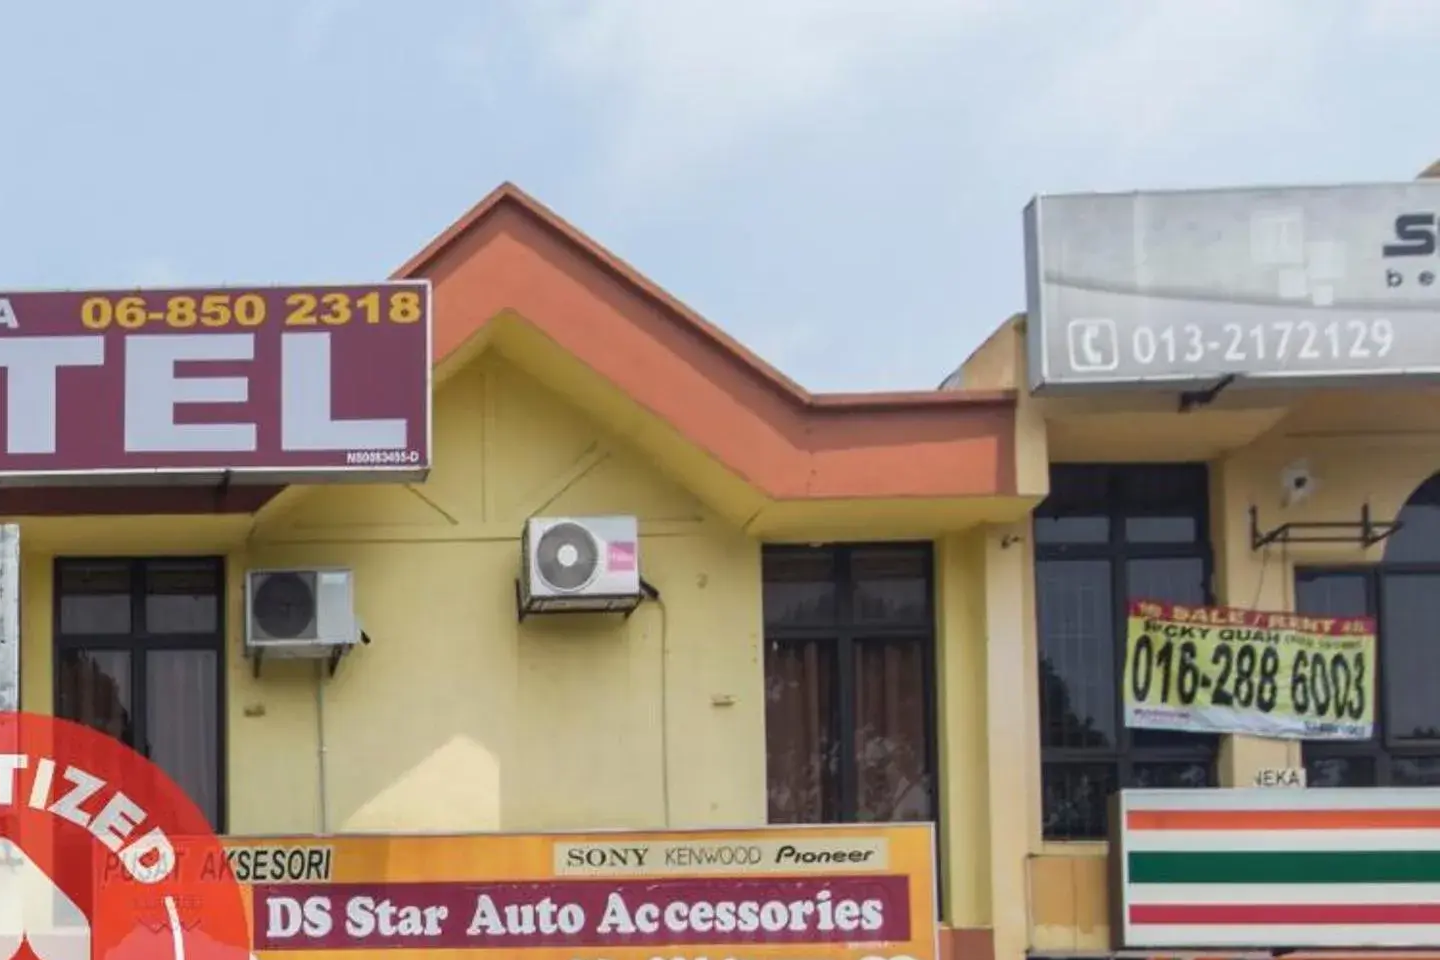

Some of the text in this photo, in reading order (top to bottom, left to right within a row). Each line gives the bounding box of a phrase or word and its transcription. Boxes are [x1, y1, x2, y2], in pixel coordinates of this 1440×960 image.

[1383, 213, 1440, 257] S
[81, 294, 266, 329] 06-850
[285, 291, 422, 326] 2318
[1132, 318, 1395, 365] 013-2172129
[1131, 634, 1367, 720] 016-288 6003
[200, 847, 333, 882] AKSESORI
[566, 845, 876, 868] SONY KENWOOD Pioneer
[266, 889, 884, 939] DS Star Auto Accessories
